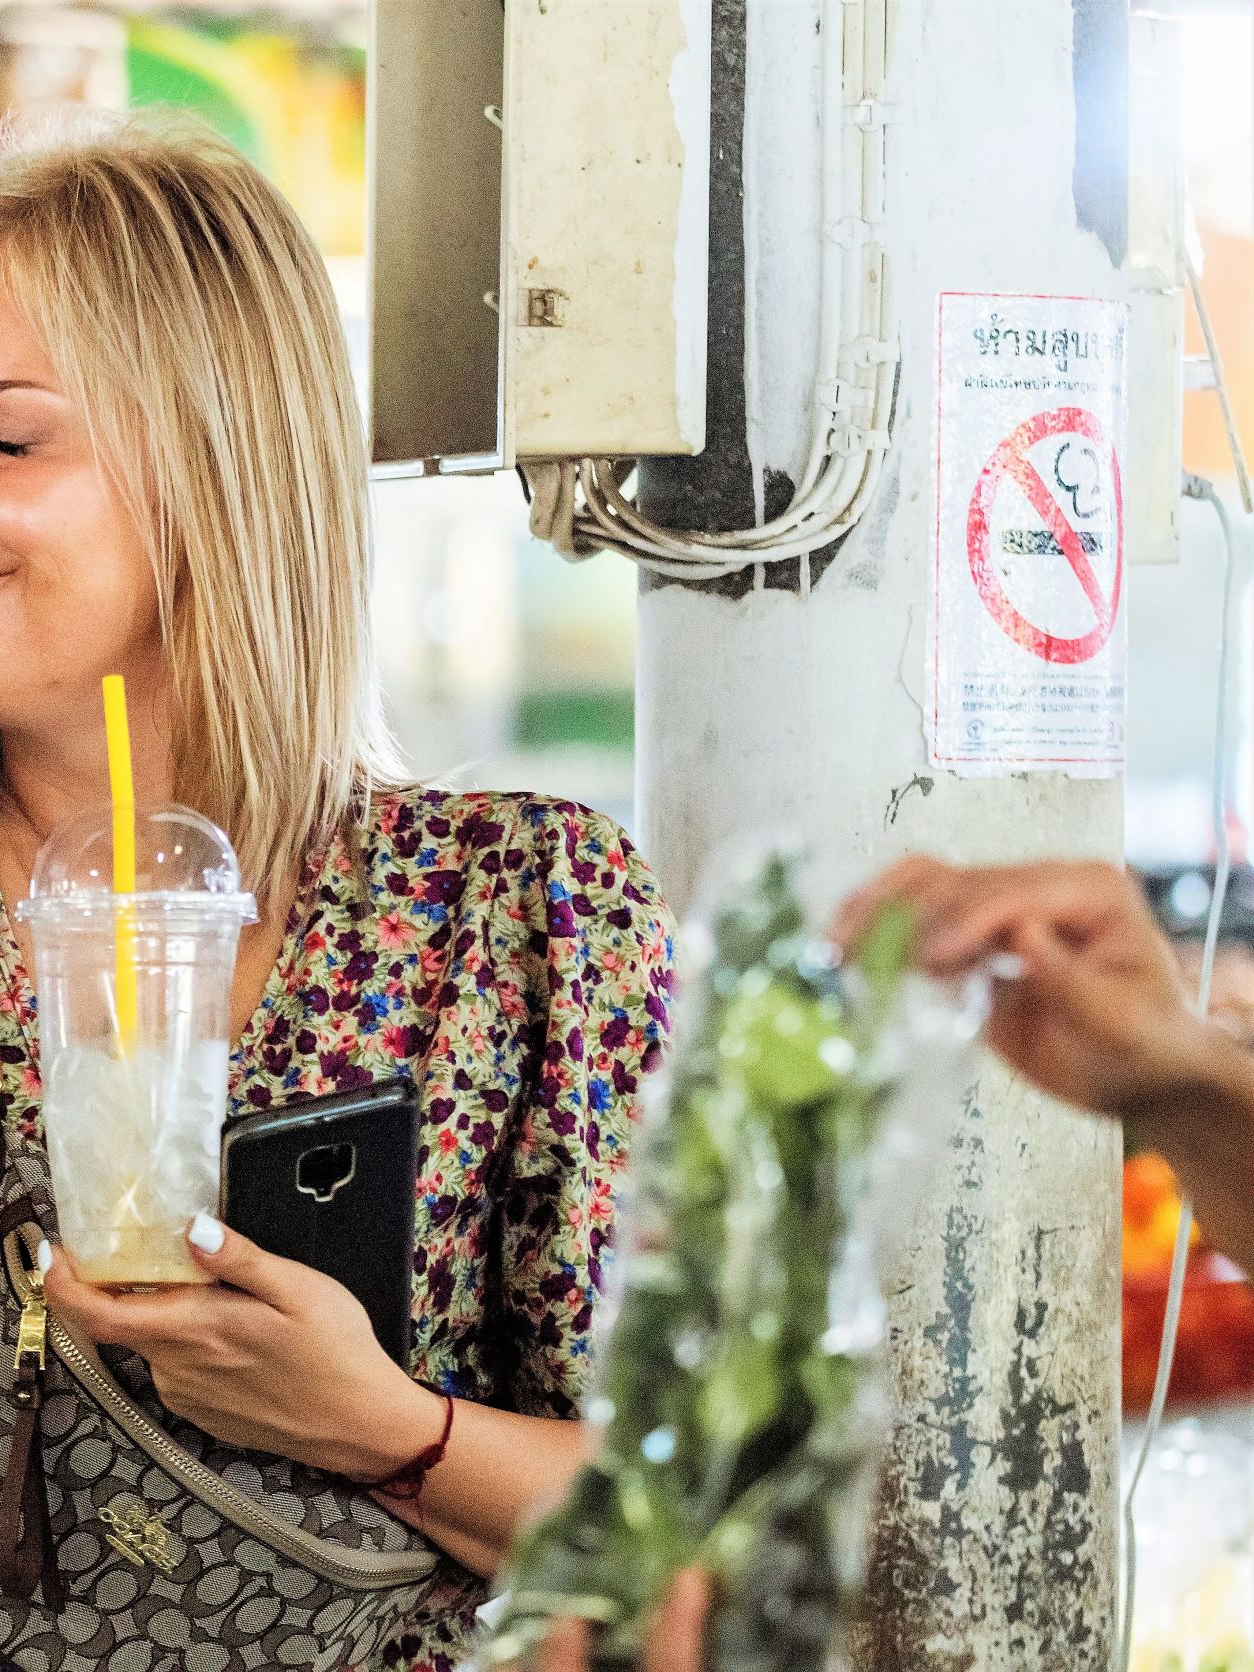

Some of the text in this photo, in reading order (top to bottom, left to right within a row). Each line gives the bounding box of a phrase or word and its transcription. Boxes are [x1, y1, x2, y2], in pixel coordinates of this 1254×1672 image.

[972, 313, 1124, 373] ห้ามสูบ
[97, 1507, 180, 1575] COACH
